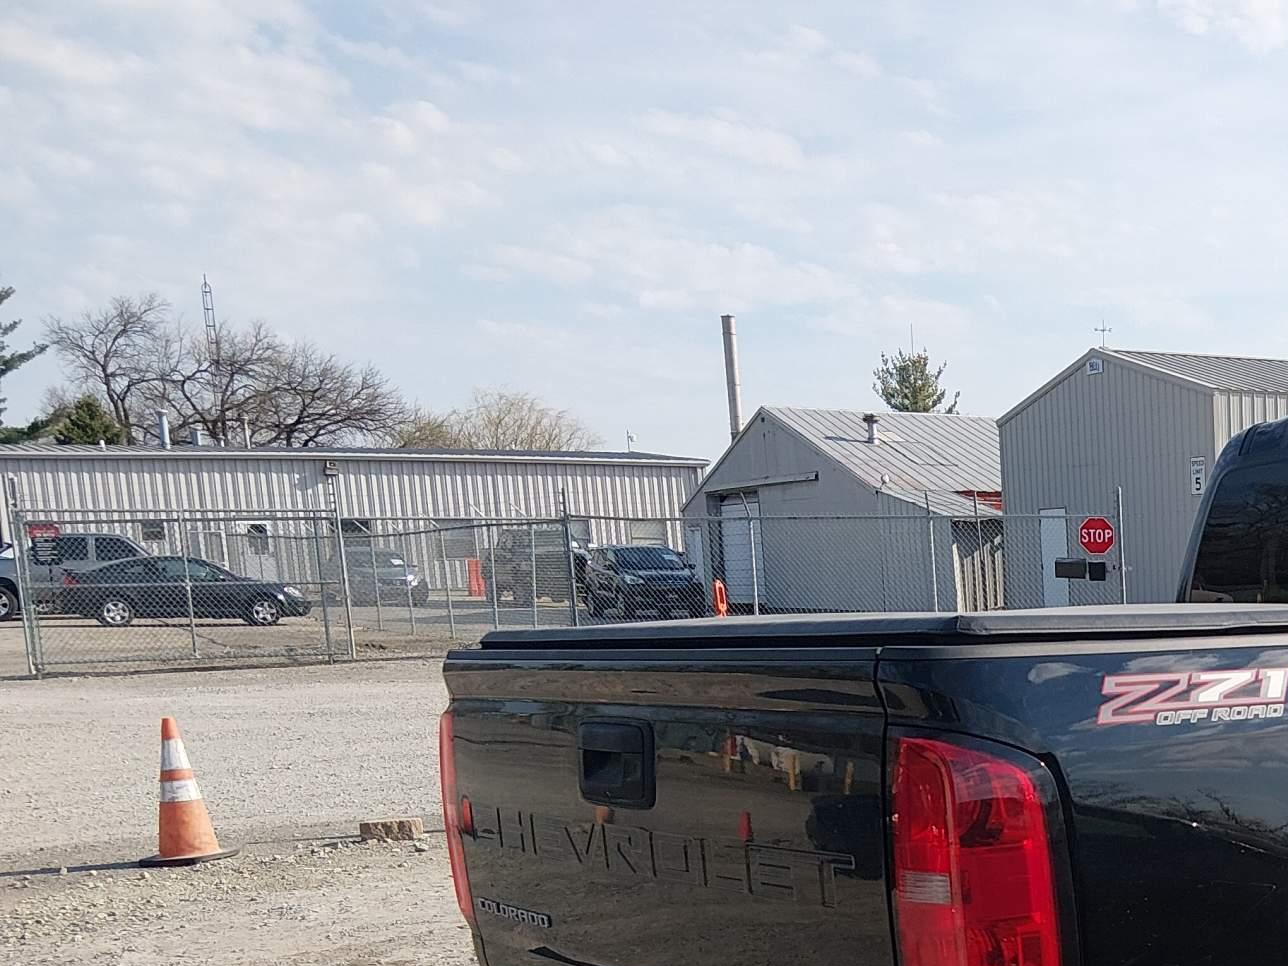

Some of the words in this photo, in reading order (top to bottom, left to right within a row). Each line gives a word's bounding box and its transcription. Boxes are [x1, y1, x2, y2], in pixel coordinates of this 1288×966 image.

[1195, 476, 1202, 491] 5
[1081, 529, 1112, 543] STOP
[1156, 708, 1208, 726] OFF
[1211, 703, 1285, 722] ROAD
[468, 805, 855, 908] CHEVROLET
[479, 898, 550, 928] COLORADO
